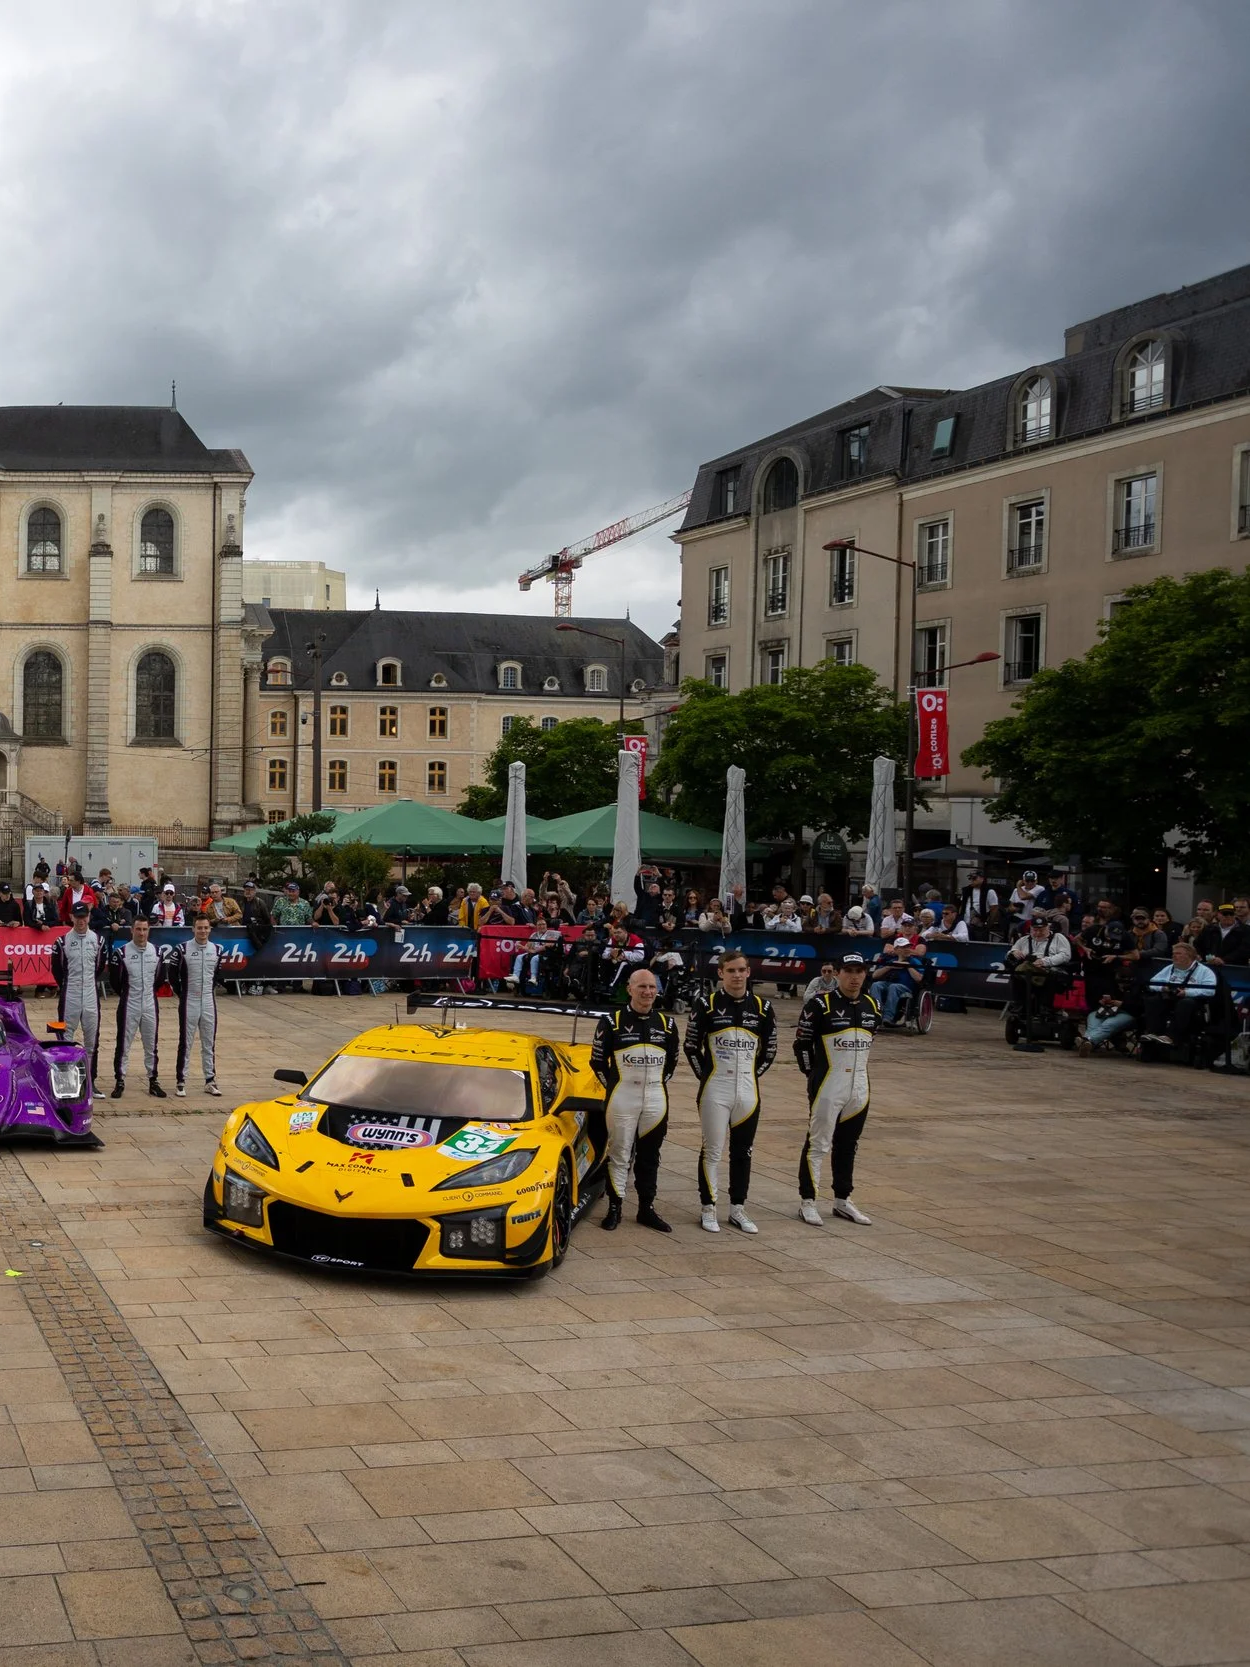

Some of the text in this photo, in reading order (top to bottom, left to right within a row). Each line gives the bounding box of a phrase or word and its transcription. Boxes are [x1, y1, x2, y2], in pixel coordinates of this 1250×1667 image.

[4, 942, 54, 956] cours
[281, 943, 317, 963] 24h
[331, 943, 366, 963] 24h
[400, 943, 432, 963] 24h
[13, 957, 52, 974] MAN
[715, 1036, 756, 1051] Keating
[354, 1044, 517, 1063] CORVETTE
[454, 1133, 506, 1154] 33
[347, 1164, 388, 1173] CONNECT
[515, 1181, 555, 1196] GOODYEAR
[330, 1257, 365, 1267] SPORT
